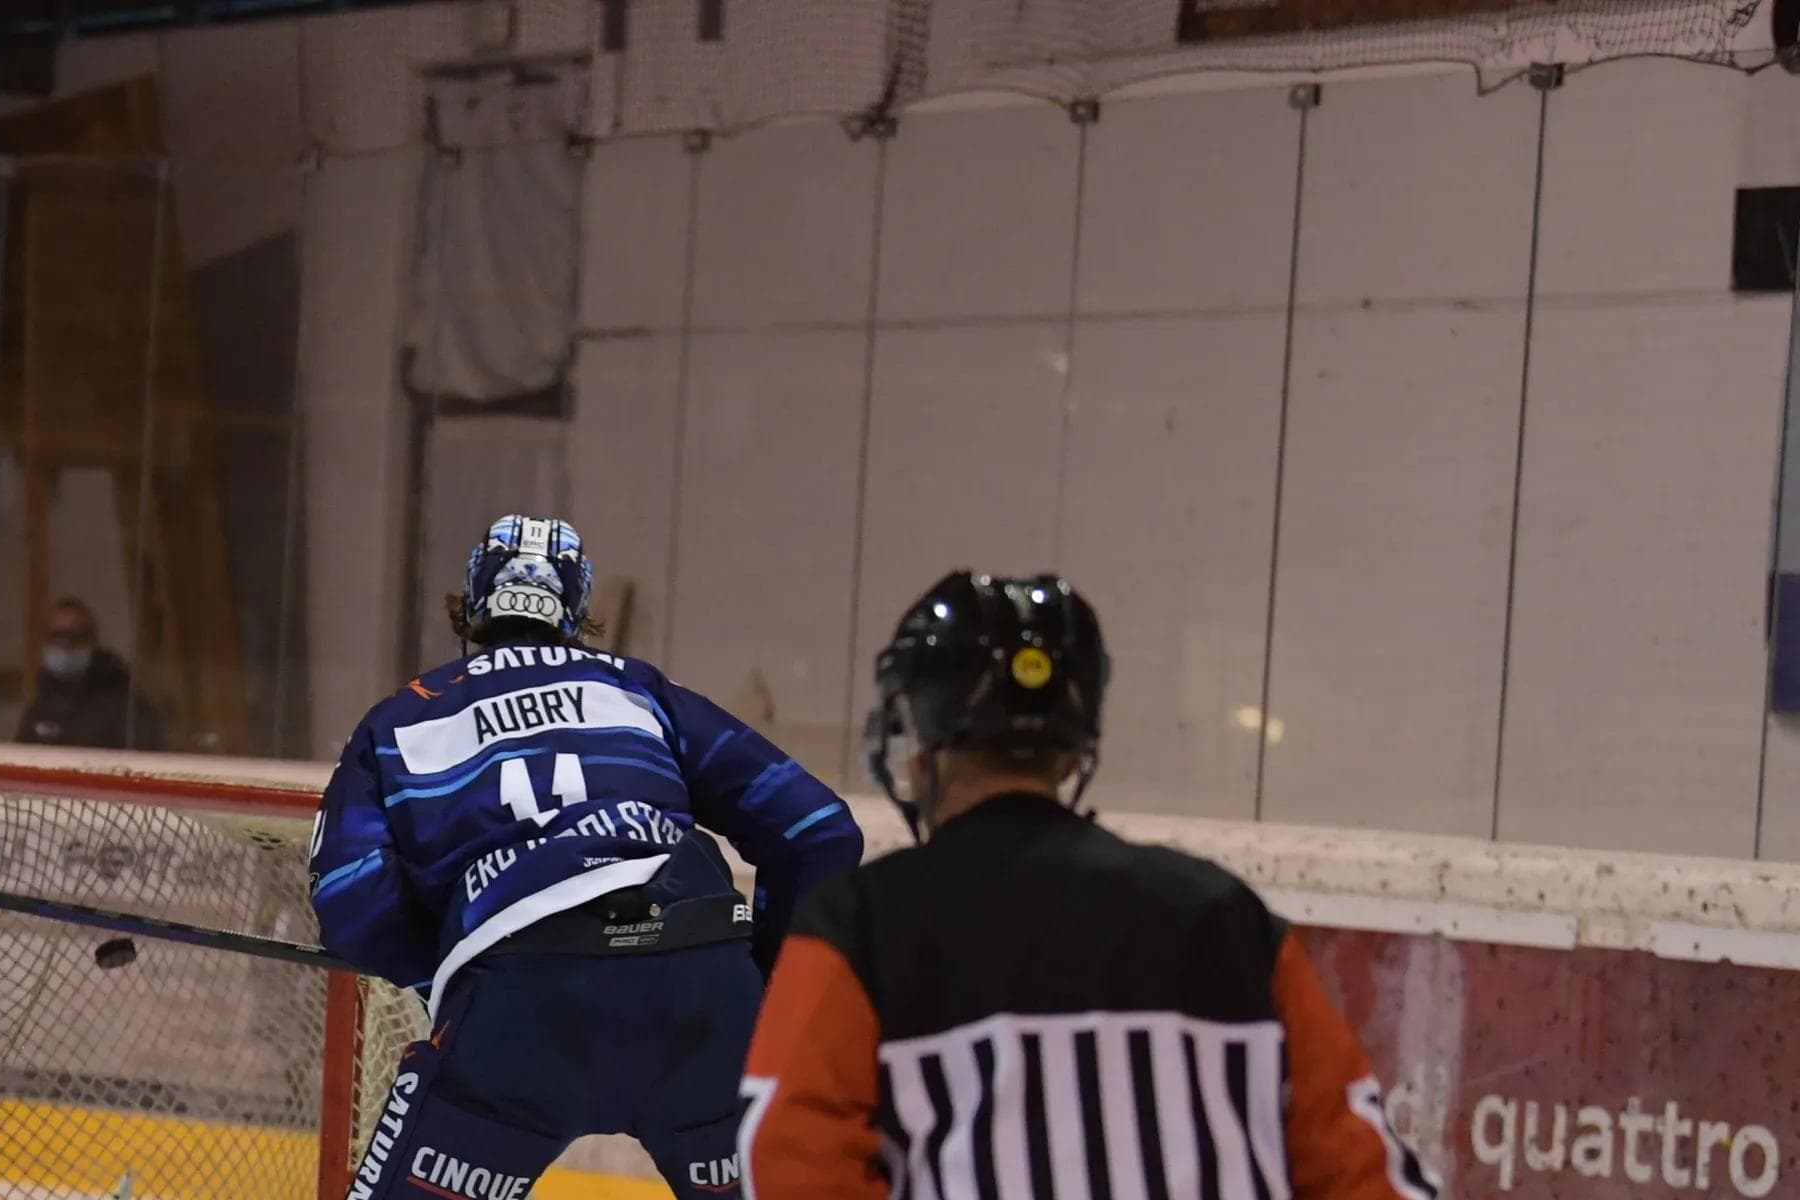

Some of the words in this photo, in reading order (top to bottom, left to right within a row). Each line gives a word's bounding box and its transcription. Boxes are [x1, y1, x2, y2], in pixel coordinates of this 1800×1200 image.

[472, 686, 586, 745] AUBRY
[603, 921, 665, 935] BAUER
[689, 1152, 740, 1186] CIN
[1470, 1094, 1780, 1199] quattro
